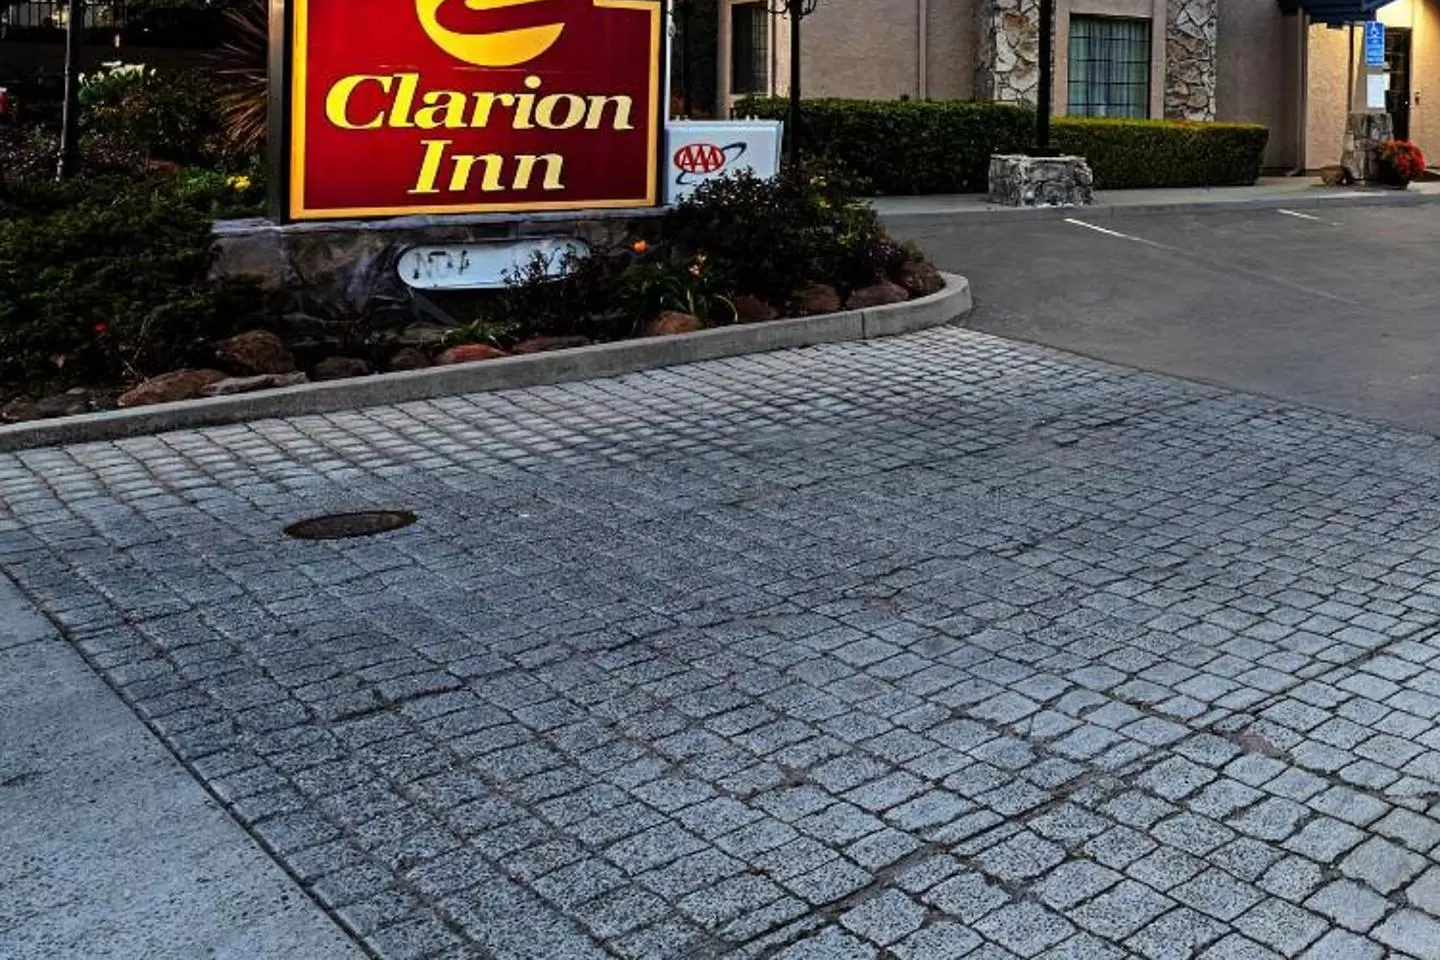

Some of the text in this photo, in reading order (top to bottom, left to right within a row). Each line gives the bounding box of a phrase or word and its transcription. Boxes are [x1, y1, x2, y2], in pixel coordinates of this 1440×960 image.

[325, 72, 634, 130] Clarion
[406, 139, 565, 194] Inn
[679, 144, 722, 173] AAA
